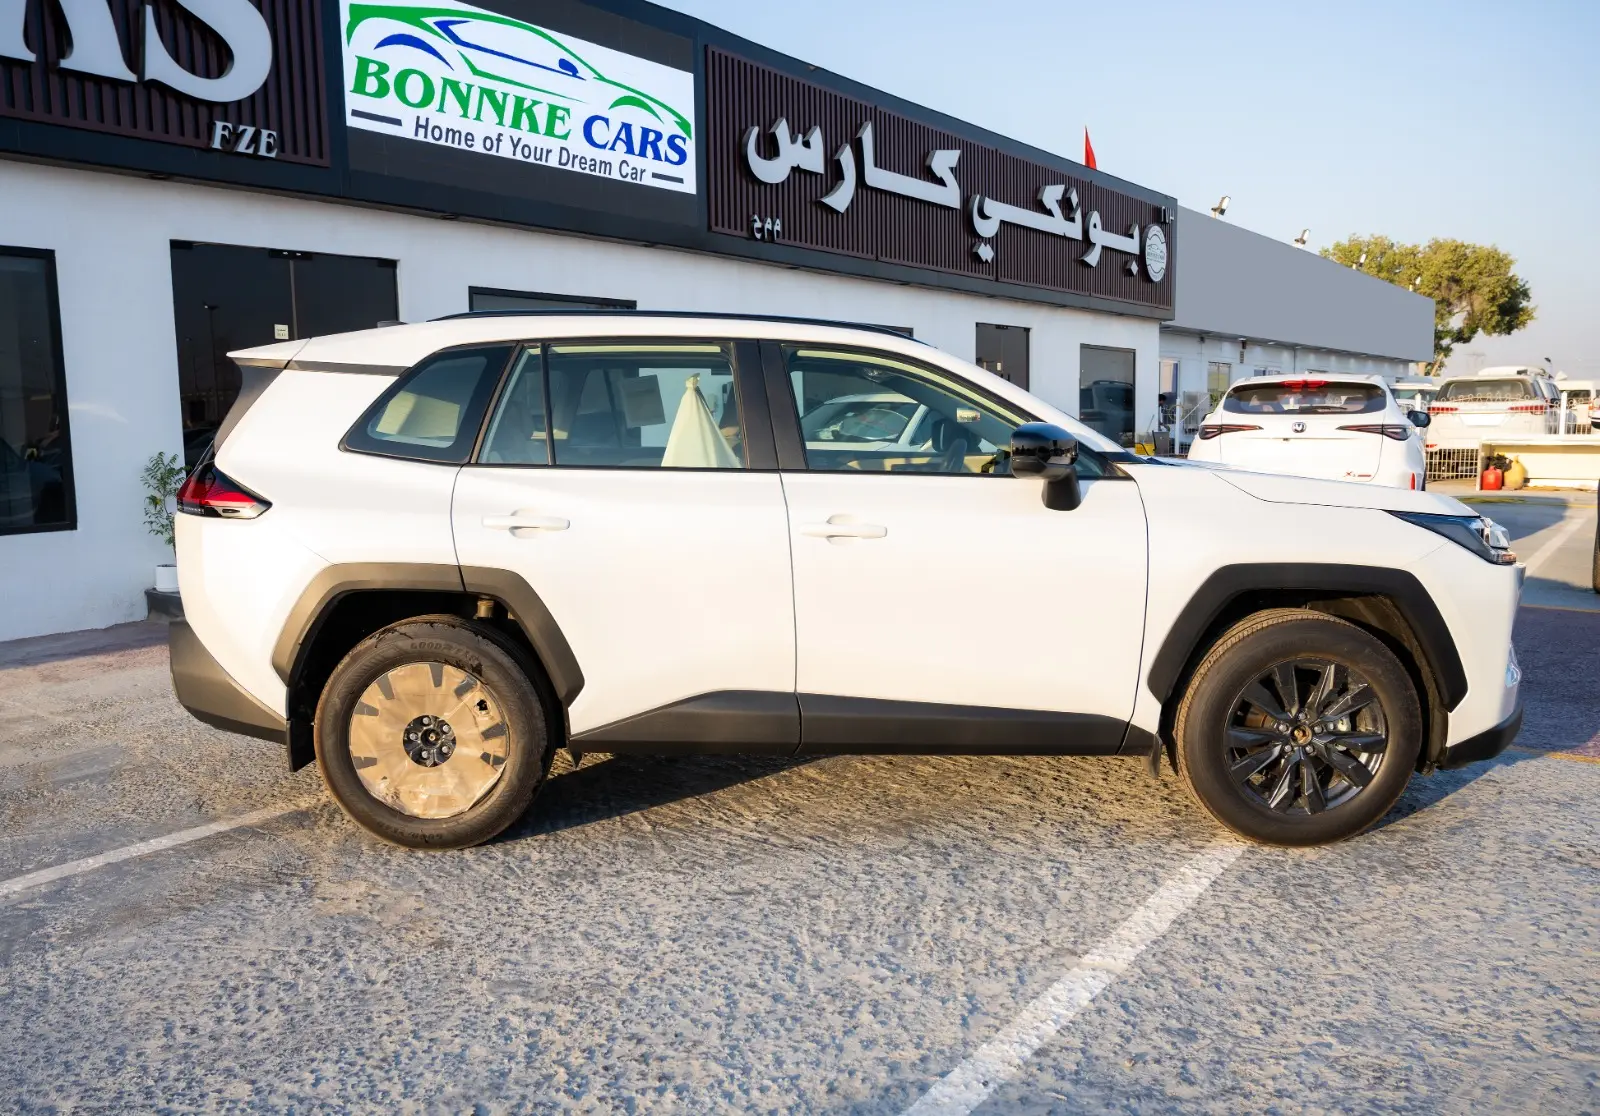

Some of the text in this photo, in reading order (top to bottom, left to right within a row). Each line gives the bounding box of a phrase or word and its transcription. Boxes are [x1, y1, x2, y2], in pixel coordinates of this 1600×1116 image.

[211, 120, 277, 158] FZE
[350, 55, 688, 166] BONNKE CARS
[414, 115, 647, 182] Home of Your Dream Car
[742, 117, 961, 213] كارس
[969, 184, 1140, 276] بونكي
